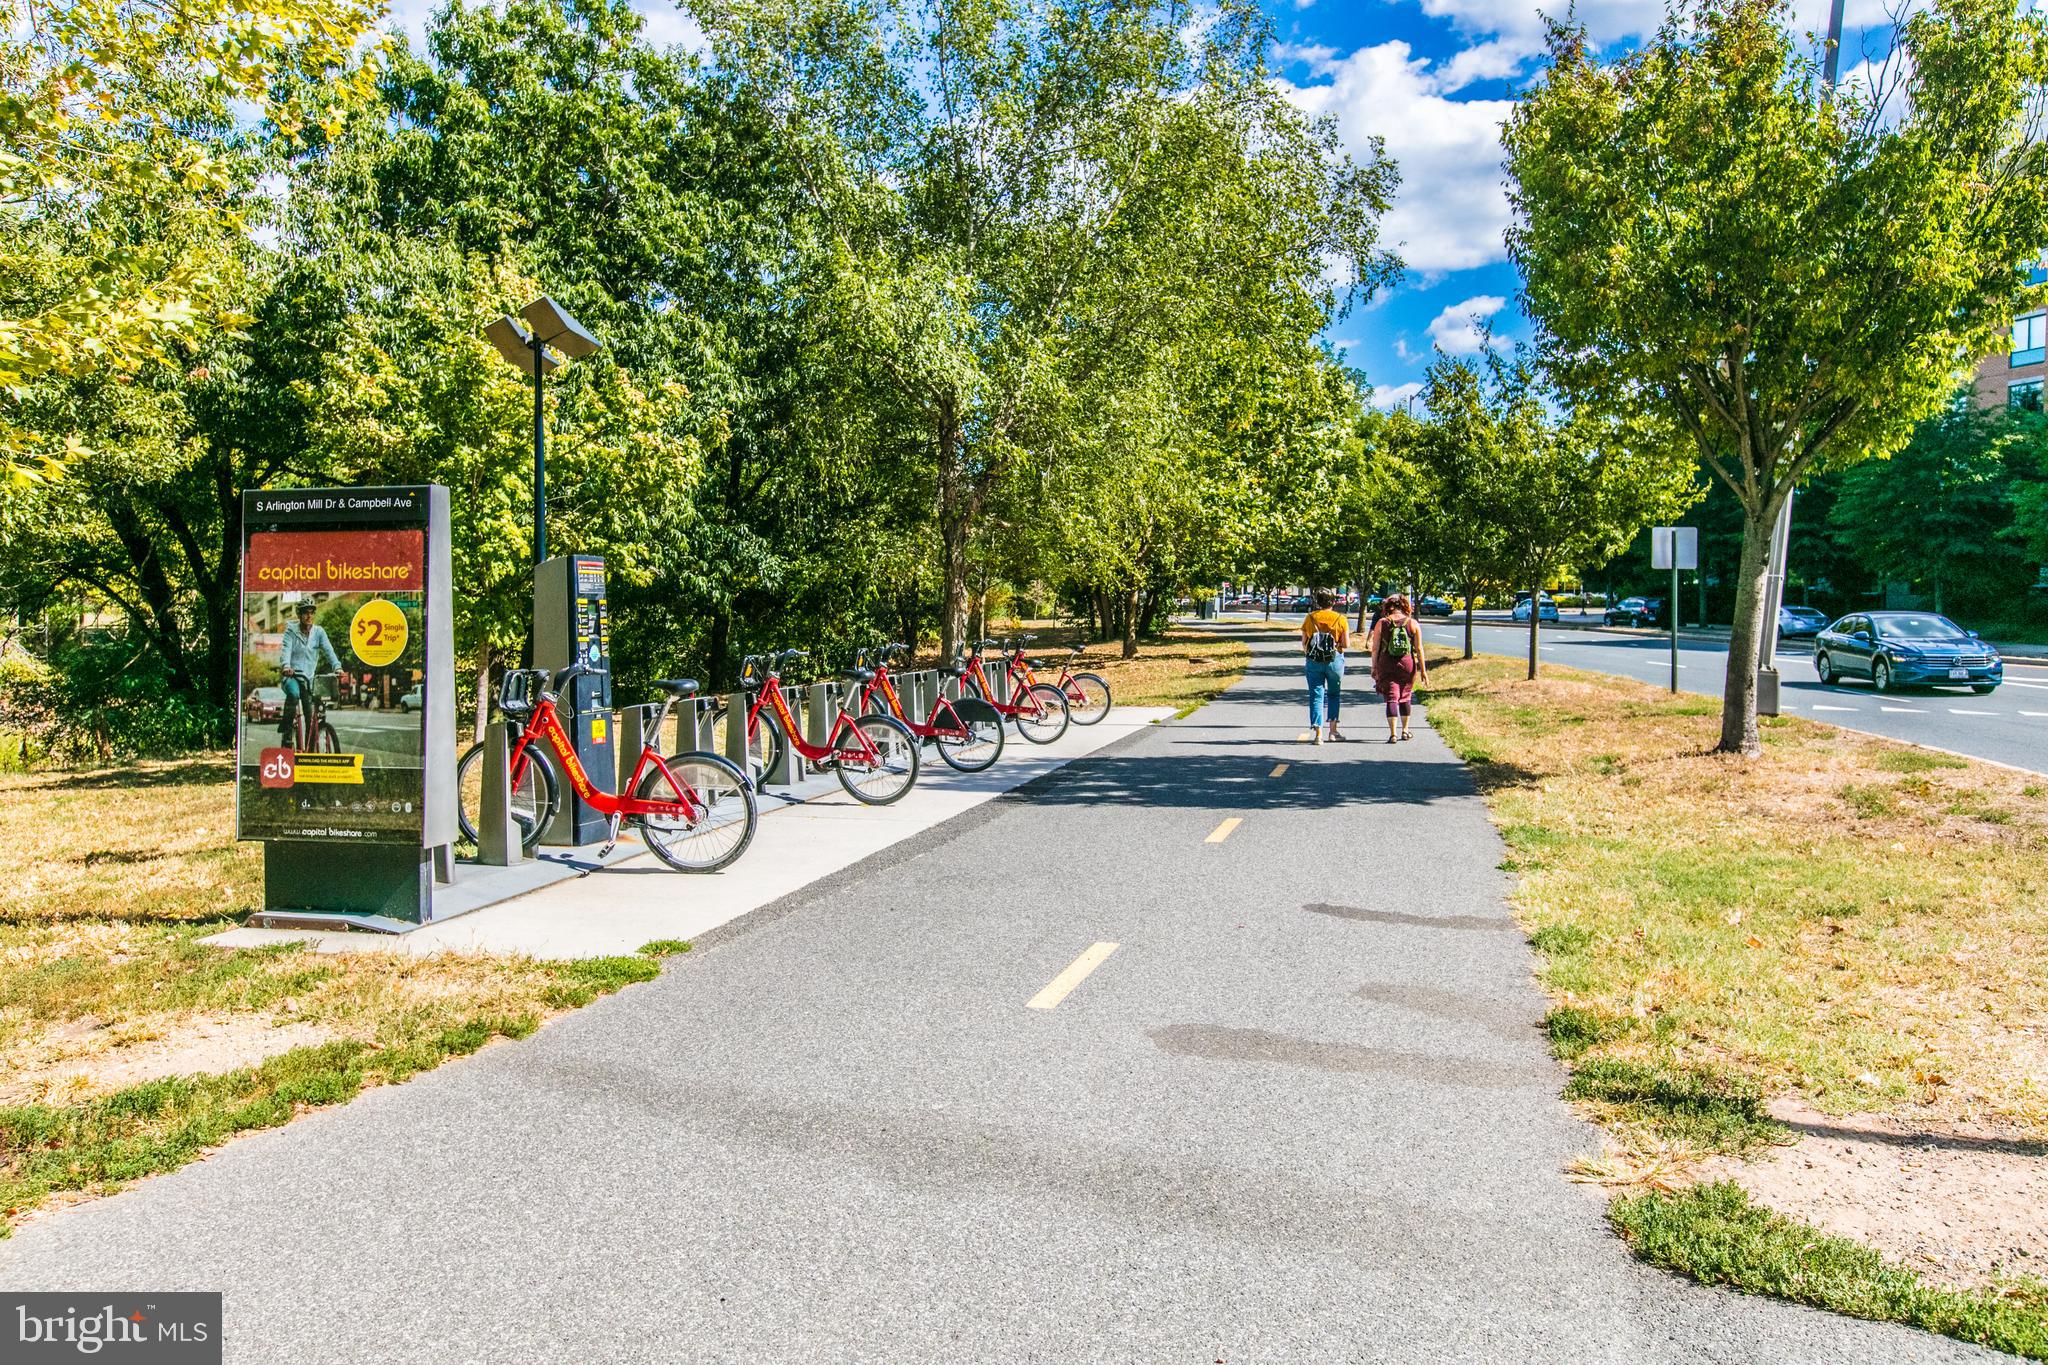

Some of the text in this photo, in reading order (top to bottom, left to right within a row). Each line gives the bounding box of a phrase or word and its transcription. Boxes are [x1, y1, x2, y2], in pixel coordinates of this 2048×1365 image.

[256, 498, 412, 513] S Arlington Mill Dr & Campbell Ave
[258, 559, 409, 585] capital bikeshare
[357, 618, 383, 646] $2
[384, 624, 405, 633] Single
[548, 726, 590, 799] capital bikeshare
